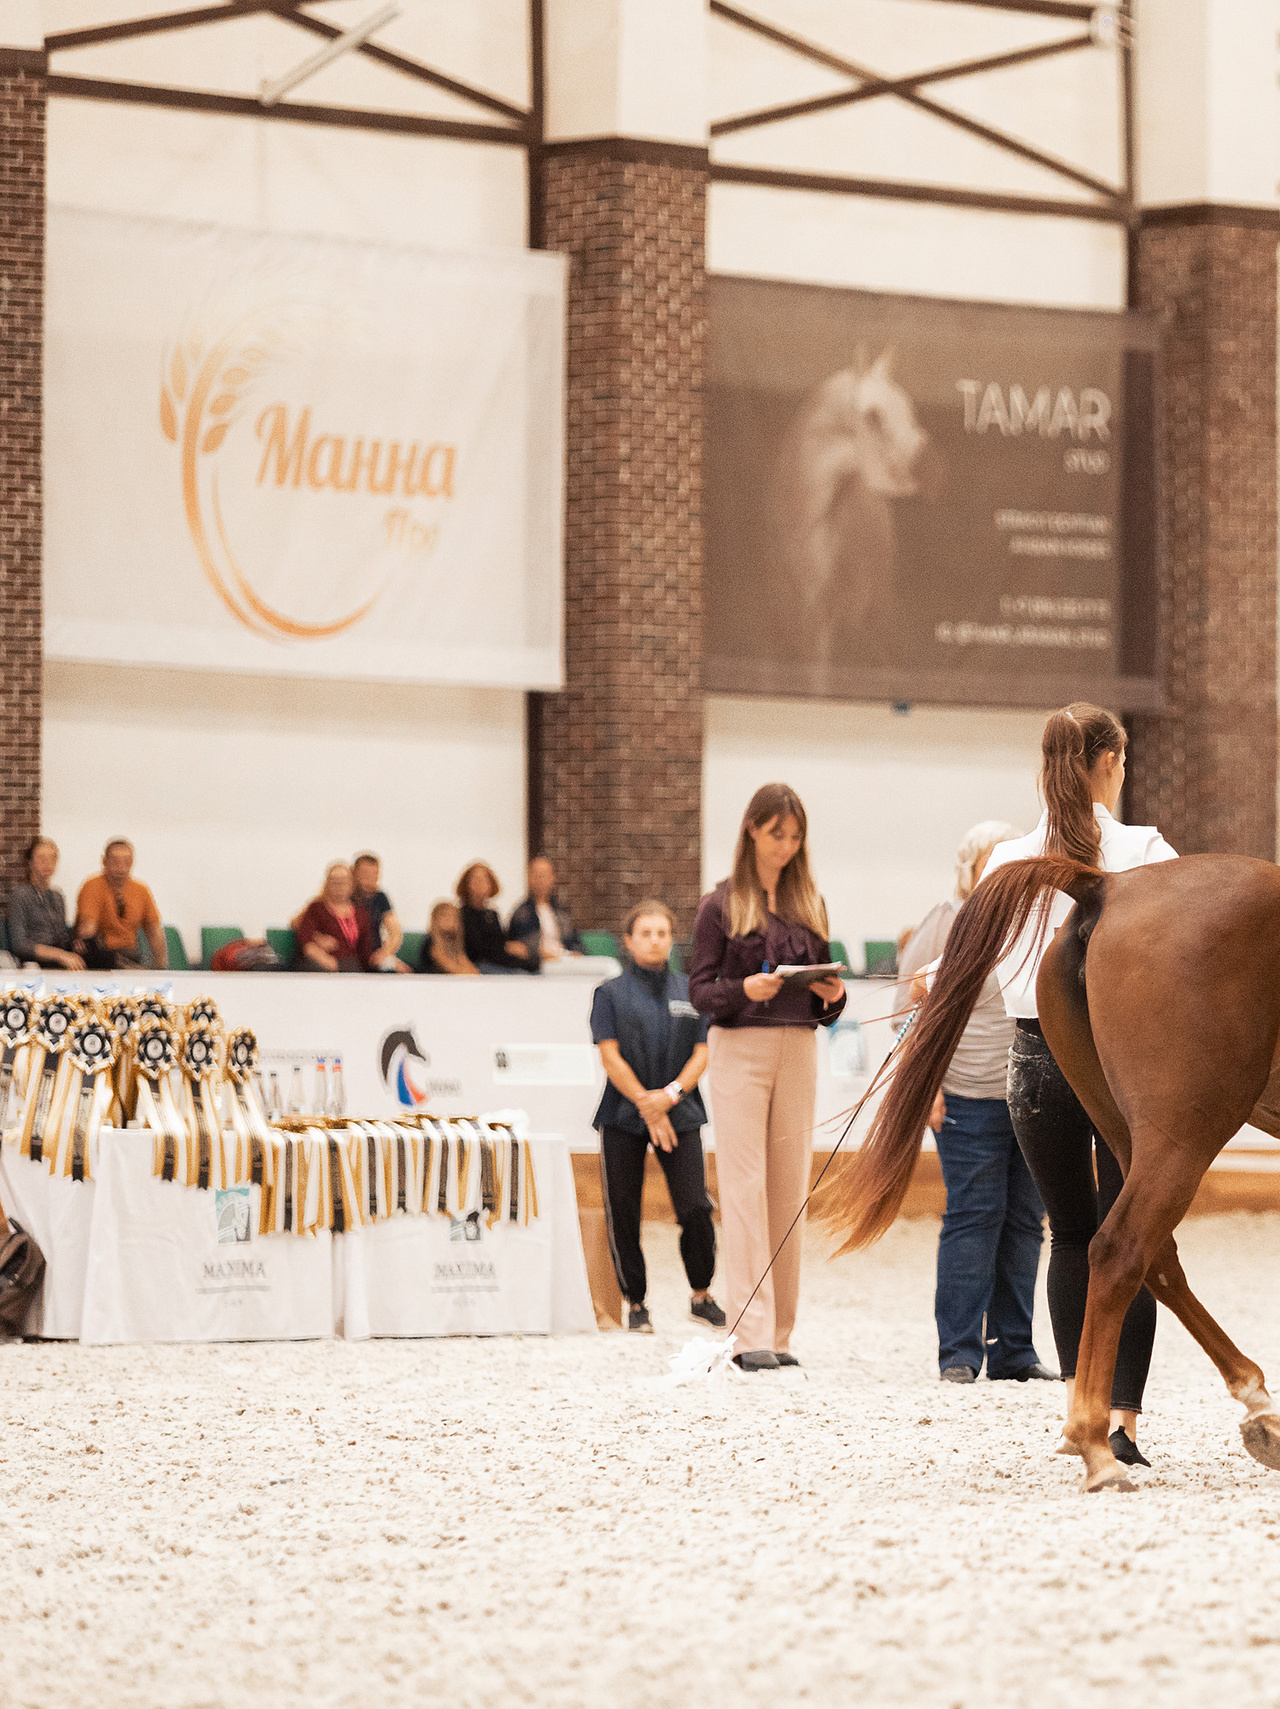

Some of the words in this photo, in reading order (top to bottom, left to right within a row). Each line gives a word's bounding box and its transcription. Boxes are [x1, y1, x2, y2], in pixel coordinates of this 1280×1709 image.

[957, 380, 1112, 441] TAMAR
[255, 402, 456, 500] Манна
[202, 1260, 267, 1279] MAXIMA
